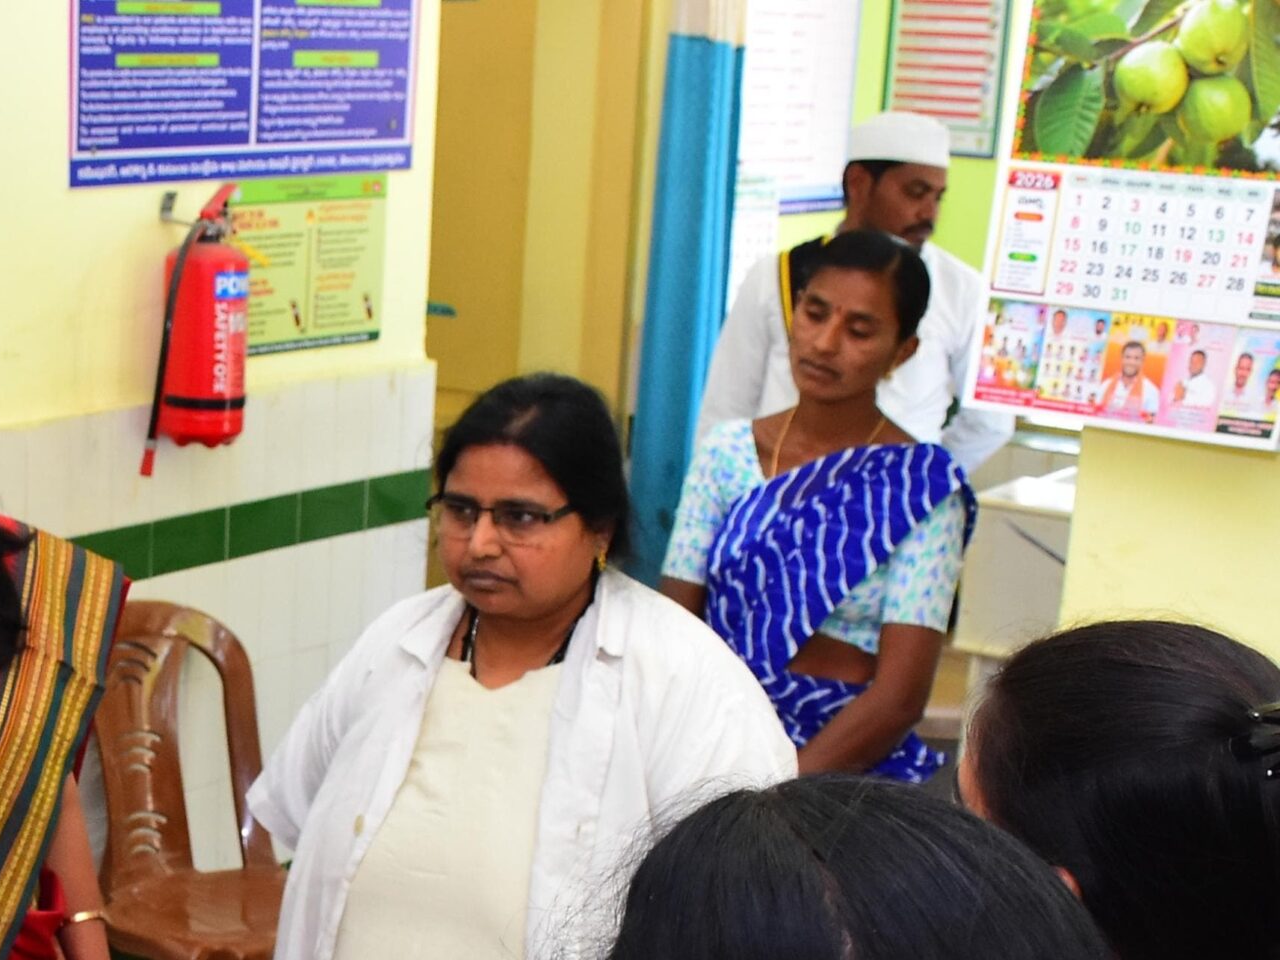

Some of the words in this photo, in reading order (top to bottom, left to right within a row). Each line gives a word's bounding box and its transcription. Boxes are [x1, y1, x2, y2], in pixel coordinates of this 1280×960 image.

[1014, 172, 1056, 190] 2026
[1076, 194, 1083, 206] 1
[1102, 196, 1111, 210] 2
[1130, 198, 1141, 213] 3
[1159, 202, 1168, 214] 4
[1186, 203, 1196, 217] 5
[1215, 206, 1225, 220] 6
[1246, 208, 1255, 221] 7
[1098, 218, 1108, 232] 9
[1124, 221, 1142, 235] 10
[1152, 224, 1167, 236] 11
[1180, 226, 1196, 241] 12
[1208, 229, 1225, 244] 13
[1237, 232, 1254, 245] 14
[1064, 238, 1081, 252] 15
[1092, 240, 1108, 254] 16
[1120, 243, 1138, 256] 17
[1147, 246, 1164, 260] 18
[1175, 249, 1193, 263] 19
[1201, 251, 1221, 266] 20
[1230, 254, 1248, 268] 21
[1059, 259, 1078, 274] 22
[1085, 262, 1104, 276] 23
[1114, 265, 1133, 279] 24
[1141, 268, 1160, 283] 25
[1169, 271, 1188, 285] 26
[1196, 274, 1217, 288] 27
[1225, 276, 1245, 291] 28
[1055, 281, 1074, 295] 29
[1082, 284, 1101, 299] 30
[1111, 287, 1128, 301] 31
